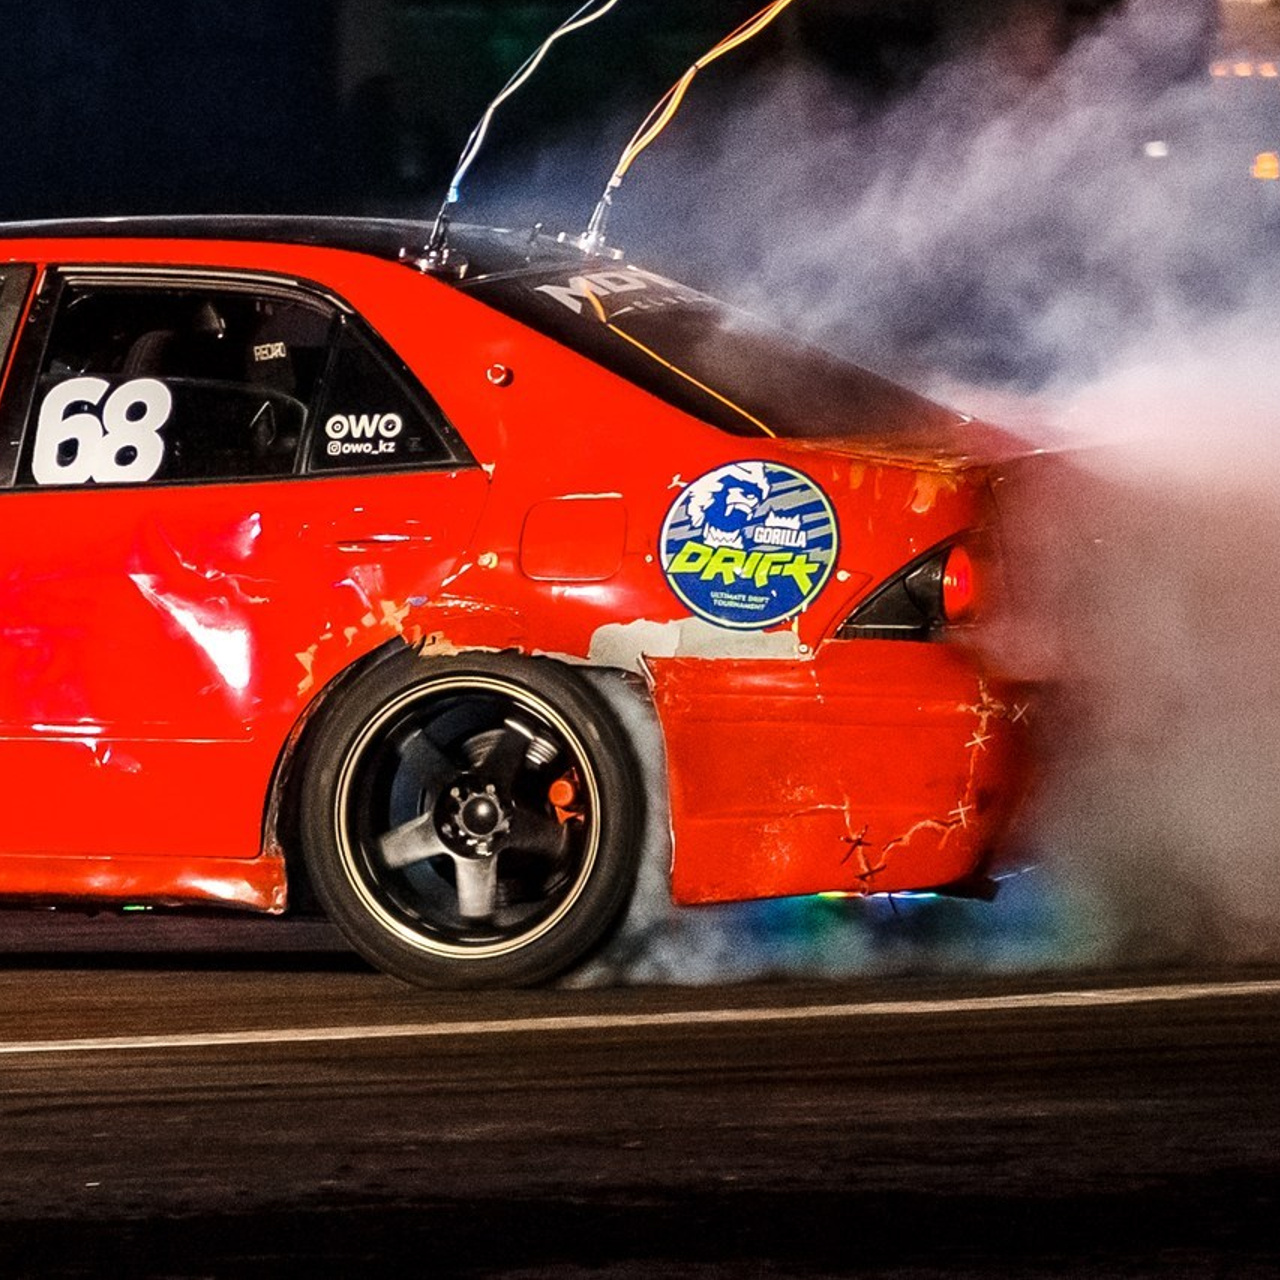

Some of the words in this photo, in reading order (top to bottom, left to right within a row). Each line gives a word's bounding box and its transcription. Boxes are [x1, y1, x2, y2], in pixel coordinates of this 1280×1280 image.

[32, 377, 172, 485] 68
[325, 413, 402, 439] OWO
[753, 526, 807, 548] GORILLA
[668, 540, 819, 596] DRIFT
[710, 591, 746, 602] ULTIMATE
[713, 599, 766, 611] TOURNAMENT
